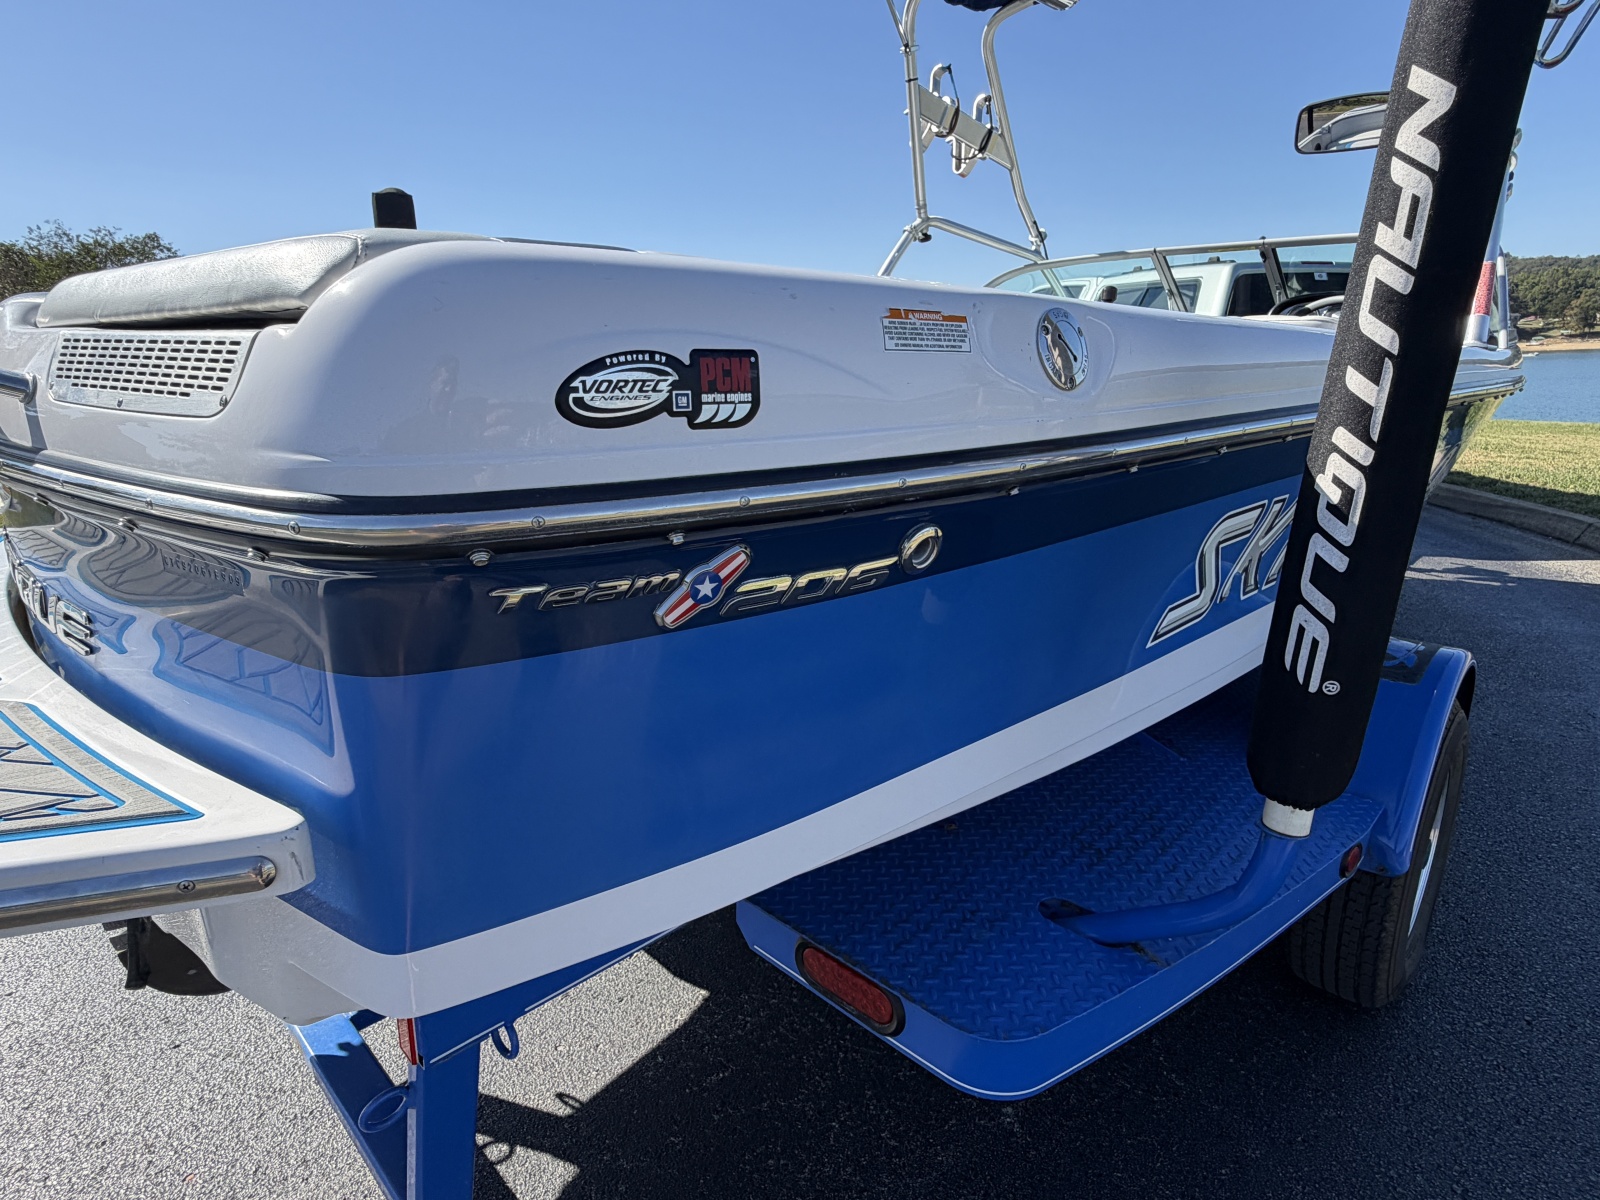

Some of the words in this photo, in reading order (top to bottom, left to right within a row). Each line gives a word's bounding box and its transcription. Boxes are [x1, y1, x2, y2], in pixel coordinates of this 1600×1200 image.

[913, 312, 943, 321] WARNING
[605, 353, 650, 366] Powered
[654, 354, 667, 364] By
[699, 357, 752, 392] PCM
[1284, 64, 1457, 694] NAUTIQUE
[578, 379, 669, 394] VORTEC
[589, 394, 653, 402] ENGINES
[701, 393, 725, 403] marine
[726, 392, 752, 404] engines
